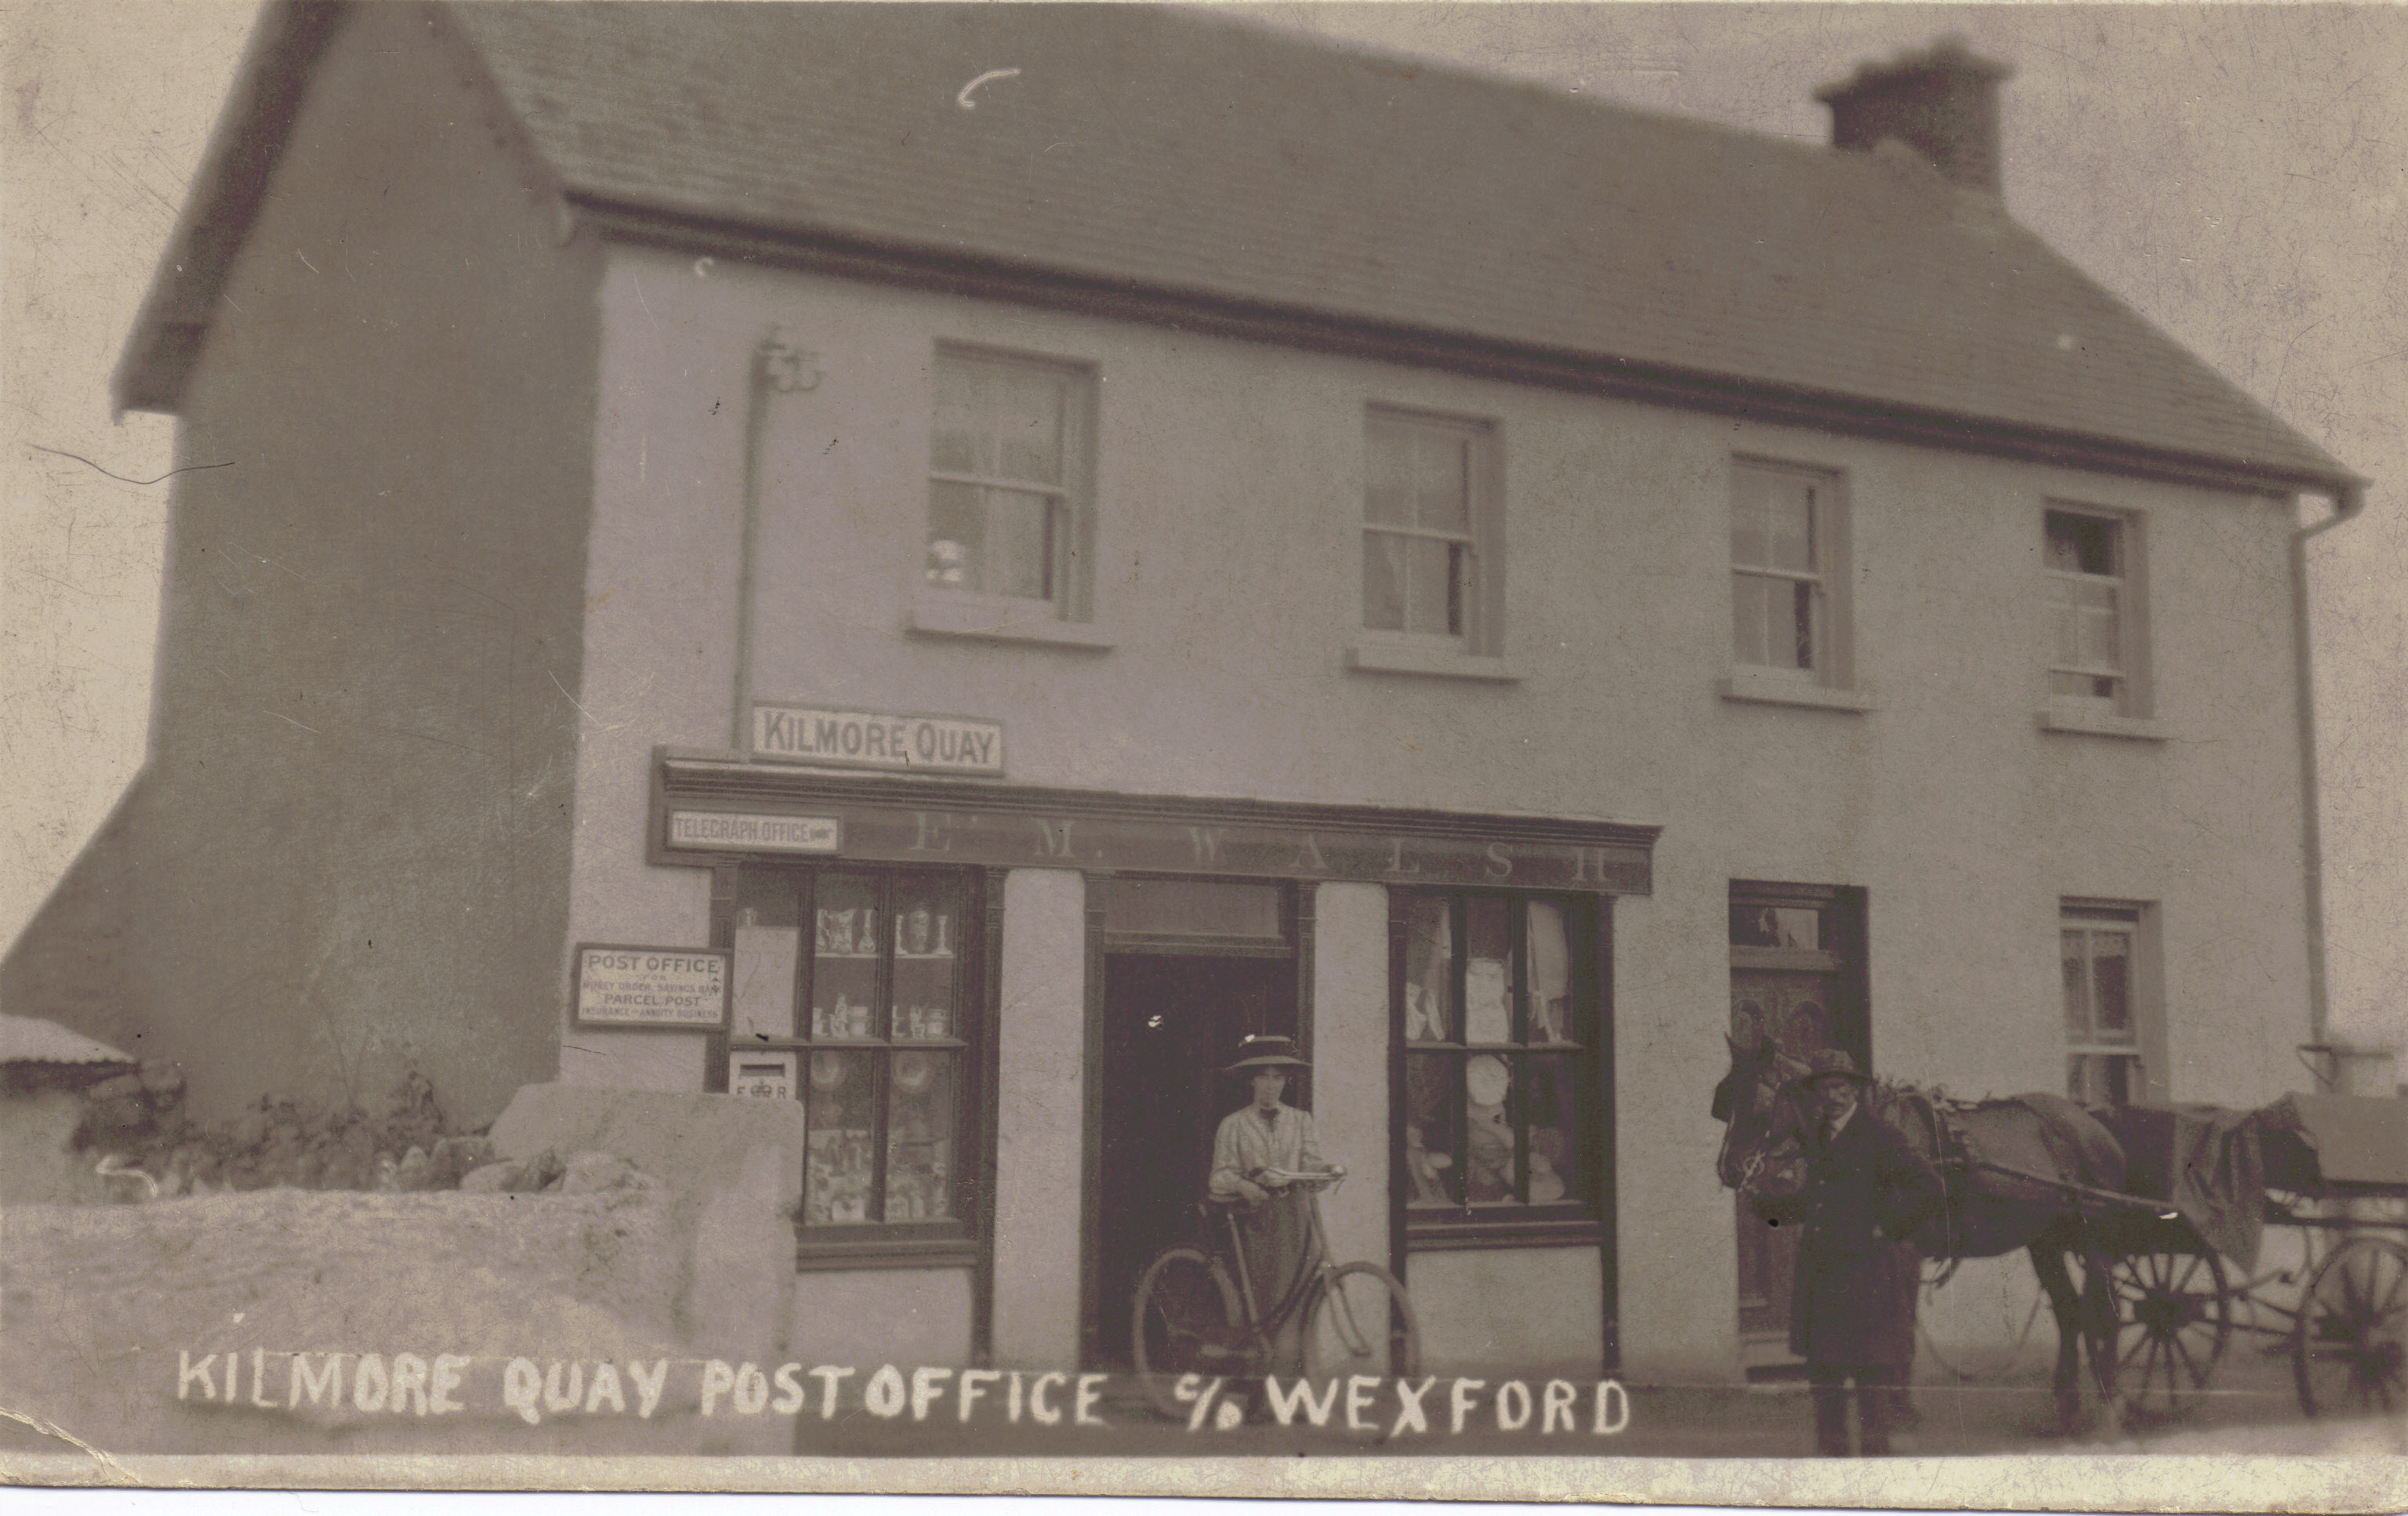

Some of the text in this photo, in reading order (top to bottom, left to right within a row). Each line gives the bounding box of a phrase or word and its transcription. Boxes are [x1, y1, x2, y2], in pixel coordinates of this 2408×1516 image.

[763, 710, 995, 763] KILMORE QUAY
[675, 817, 811, 843] TELEGRAPH OFFICE
[589, 955, 719, 974] POST OFFICE
[604, 994, 702, 1007] PARCEL POST
[778, 1086, 787, 1098] R
